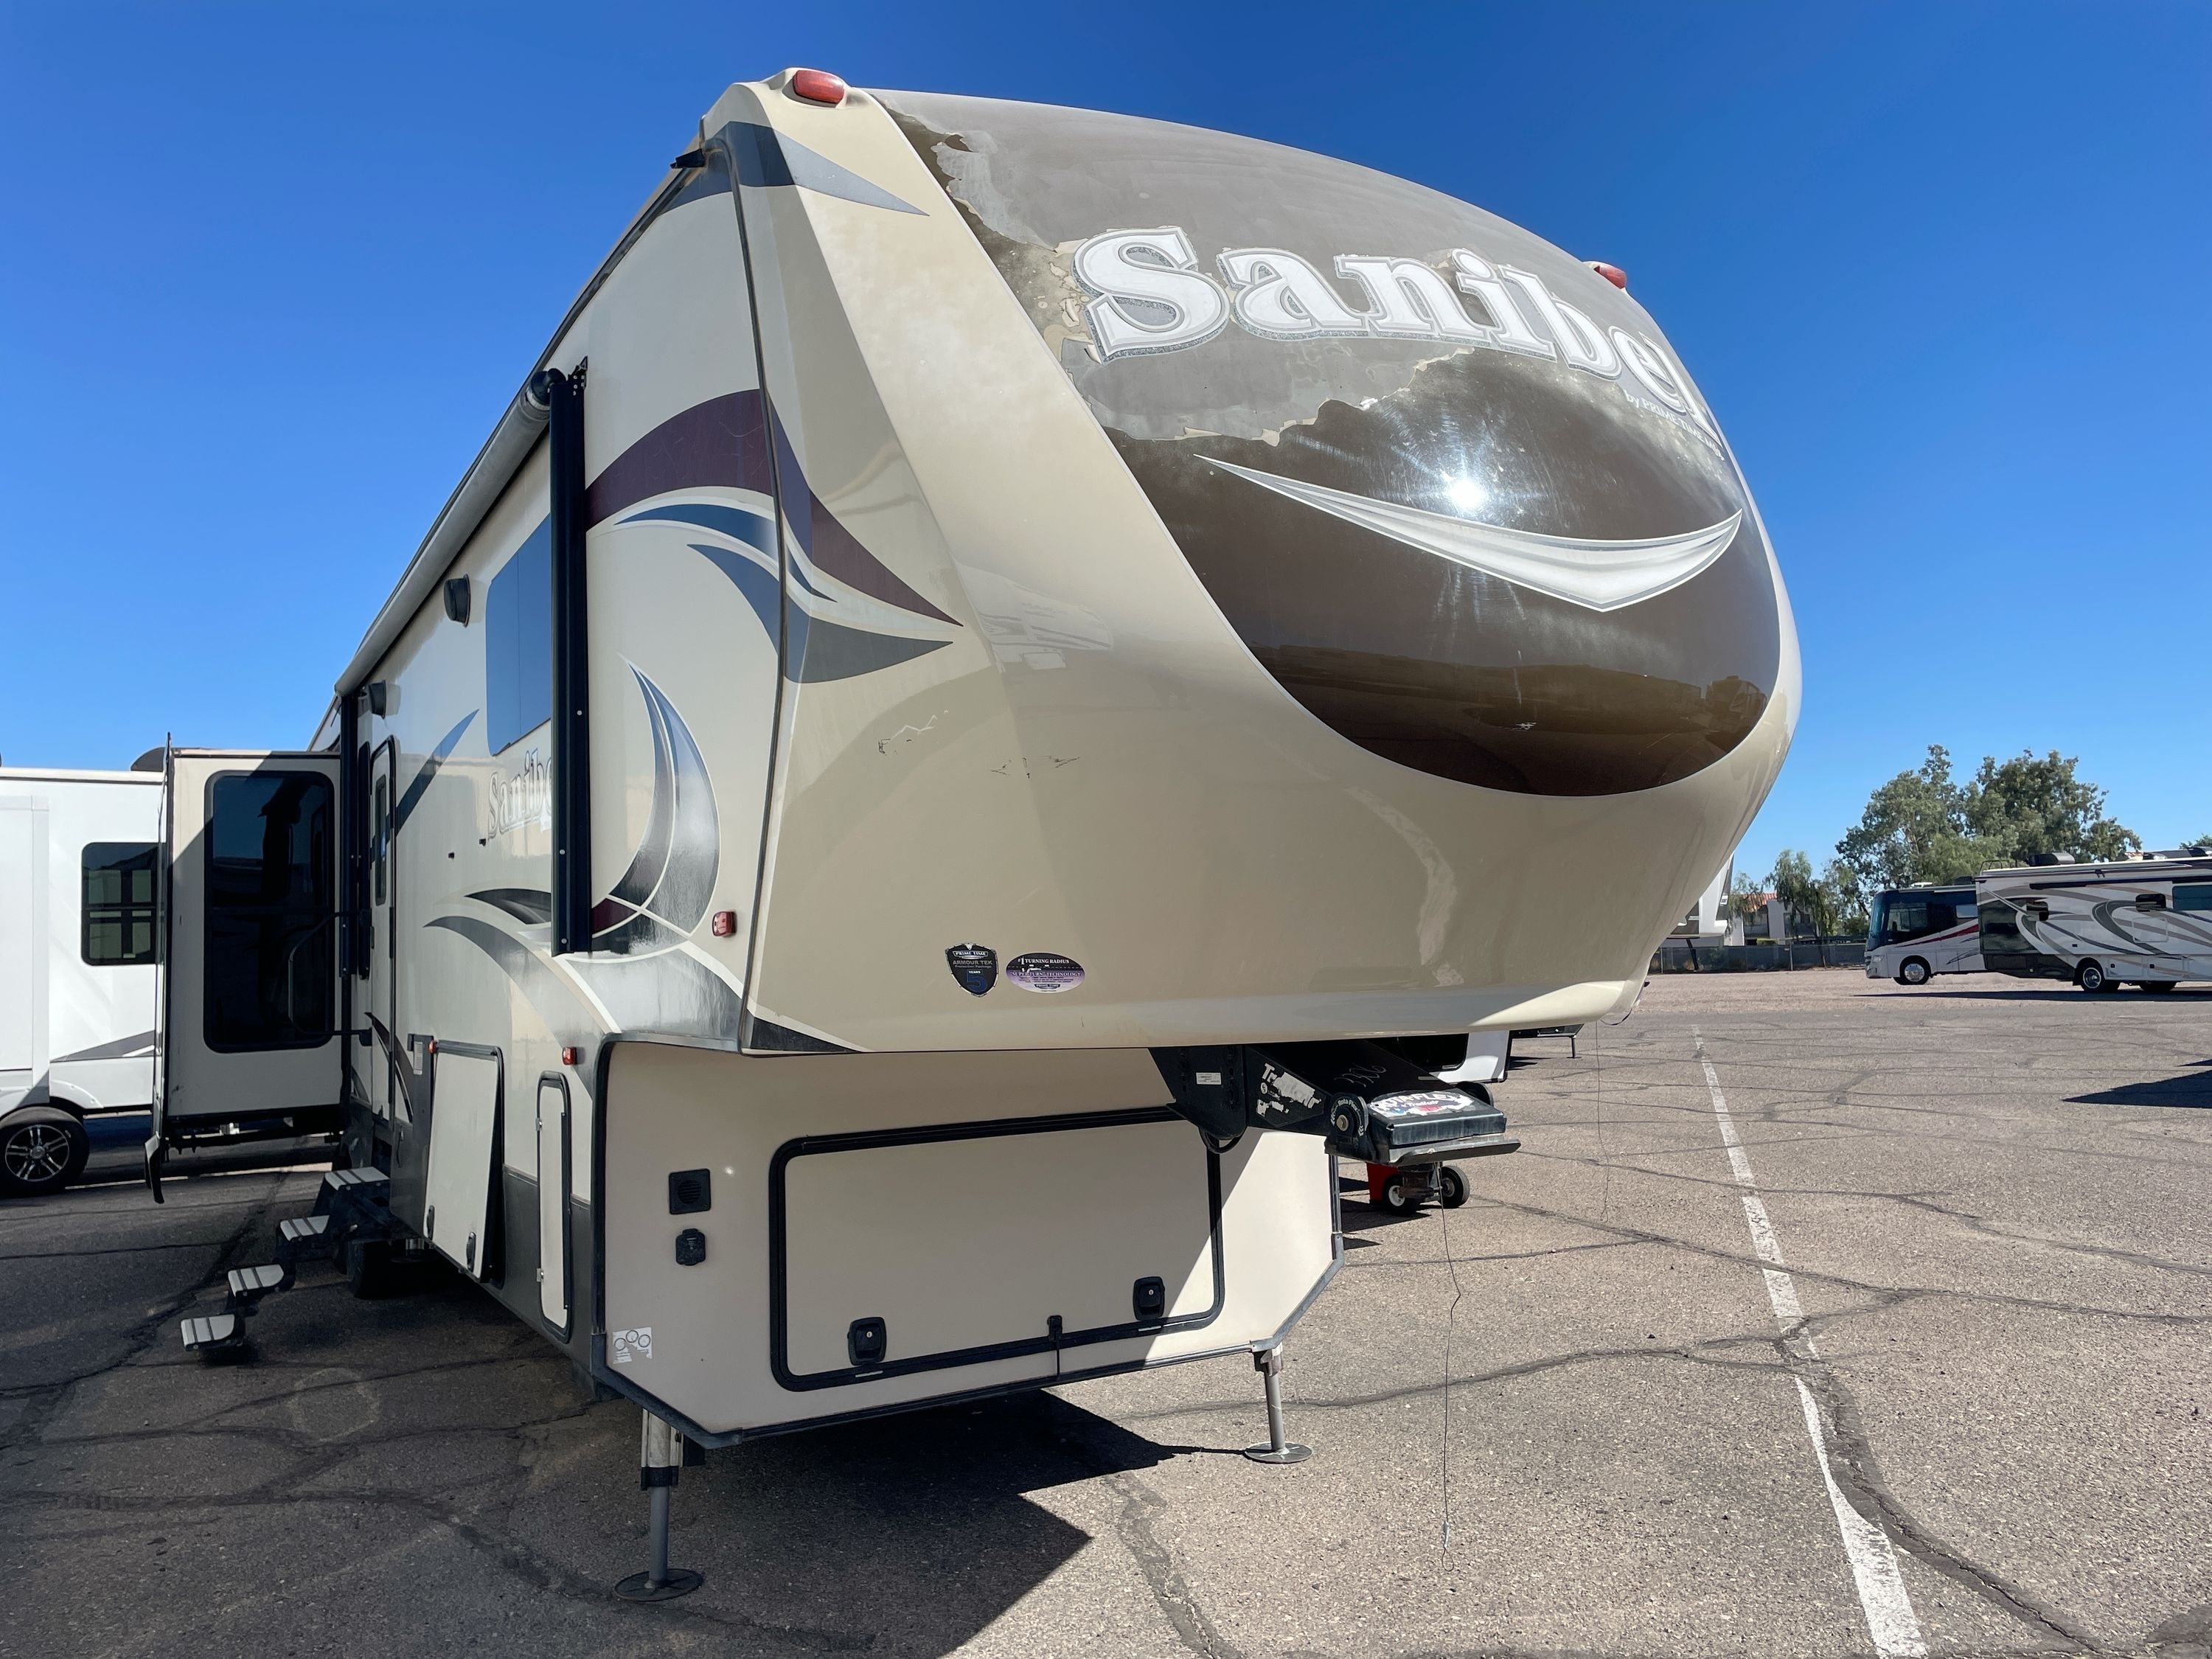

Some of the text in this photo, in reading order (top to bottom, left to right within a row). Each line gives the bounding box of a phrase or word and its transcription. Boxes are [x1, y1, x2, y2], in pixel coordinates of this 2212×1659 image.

[1071, 226, 1724, 450] Sanibel
[1623, 389, 1641, 408] by
[1642, 397, 1680, 426] PRIME
[1677, 417, 1705, 442] TIME
[487, 748, 552, 841] Sanib
[1018, 956, 1025, 965] #1
[967, 970, 988, 992] 5
[1338, 1099, 1358, 1112] Rota Flex
